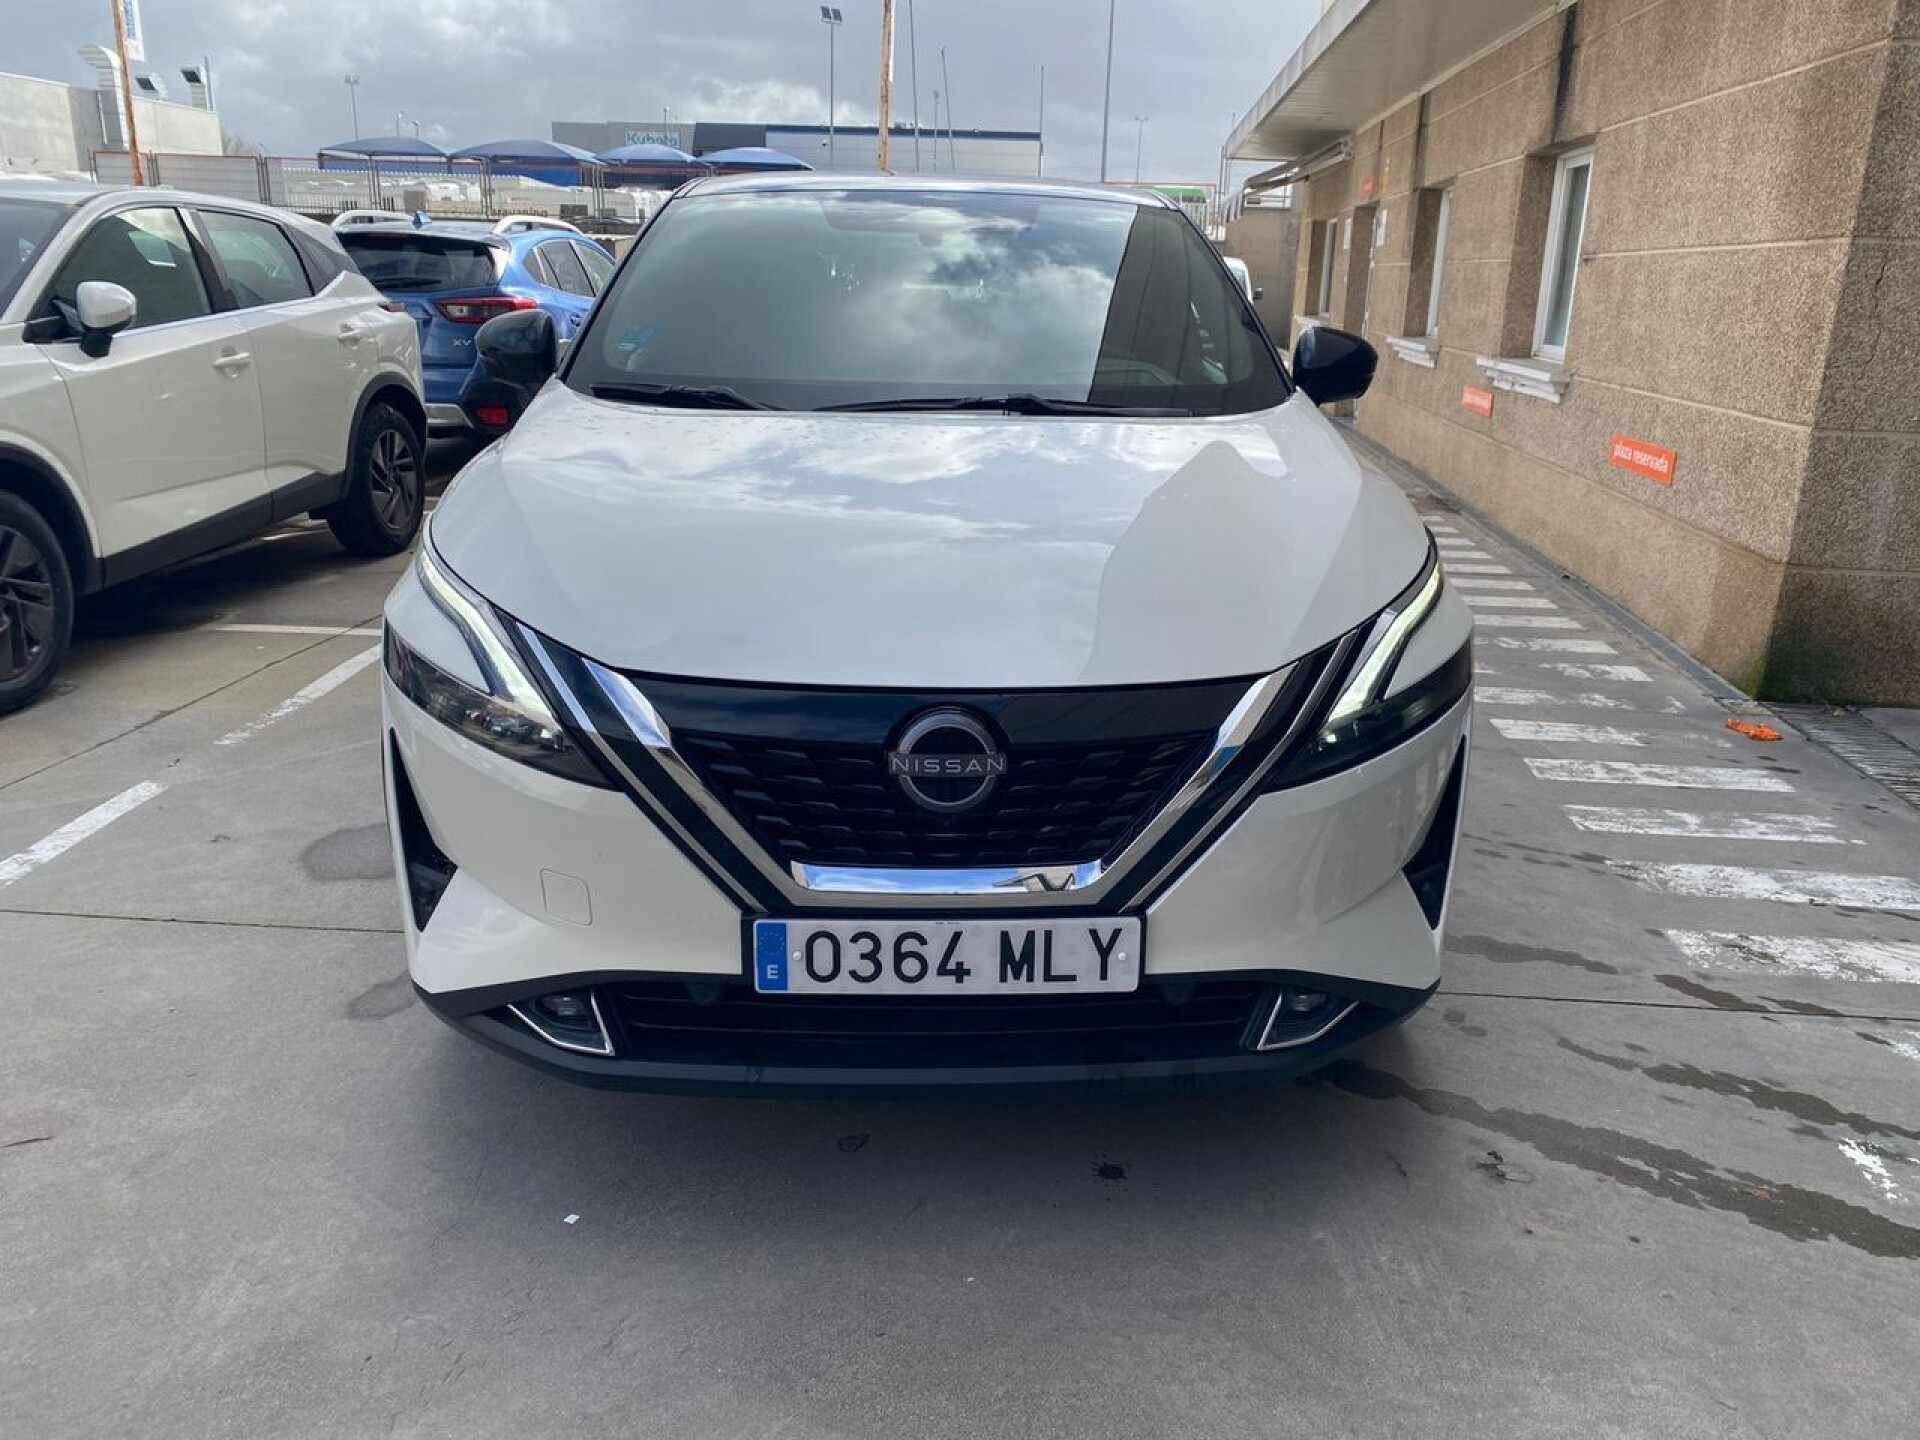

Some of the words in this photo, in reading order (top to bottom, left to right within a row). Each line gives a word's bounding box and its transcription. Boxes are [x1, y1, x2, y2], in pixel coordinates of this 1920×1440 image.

[626, 132, 678, 147] Kubota
[892, 758, 1003, 773] NISSAN
[805, 930, 971, 983] 0364
[1000, 928, 1123, 983] MLY
[767, 965, 779, 978] E
